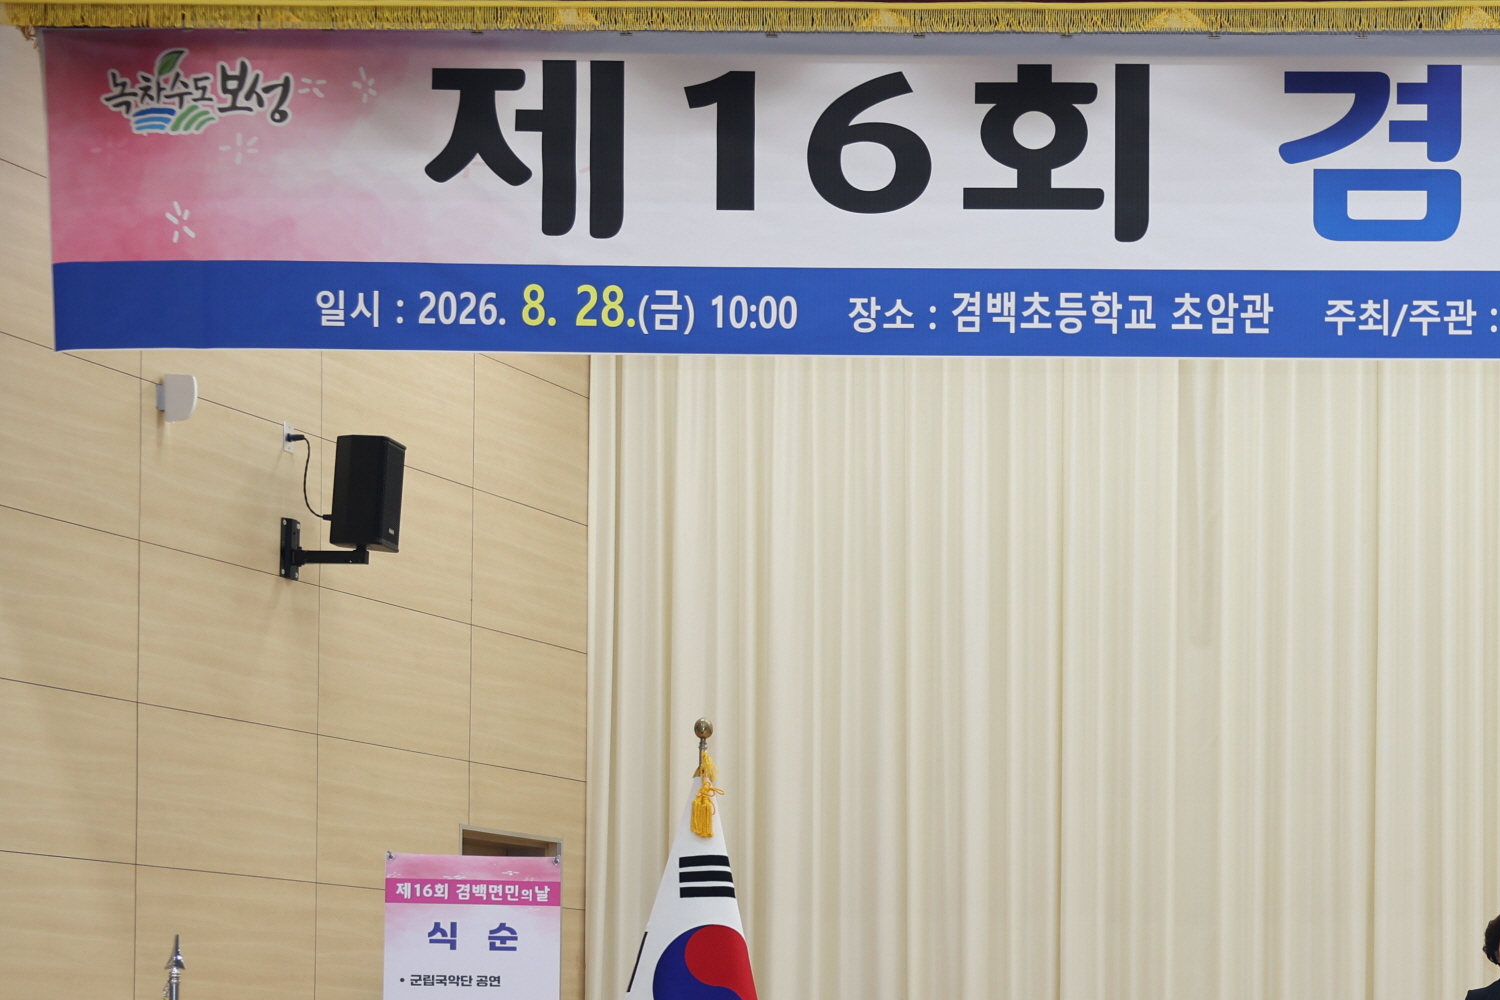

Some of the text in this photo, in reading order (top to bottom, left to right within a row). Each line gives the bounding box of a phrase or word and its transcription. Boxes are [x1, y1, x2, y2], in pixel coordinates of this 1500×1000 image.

[424, 59, 1150, 243] 제16회
[315, 289, 381, 329] 일시
[418, 294, 506, 326] 2026.
[521, 283, 557, 327] 8.
[711, 294, 798, 330] 10:00
[848, 296, 915, 334] 장소
[951, 291, 1157, 335] 겸백초등학교
[1171, 292, 1274, 335] 초암관
[1324, 298, 1477, 338] 주최/주관
[395, 882, 449, 900] 제16회
[410, 974, 501, 988] 군립국악단 공연
